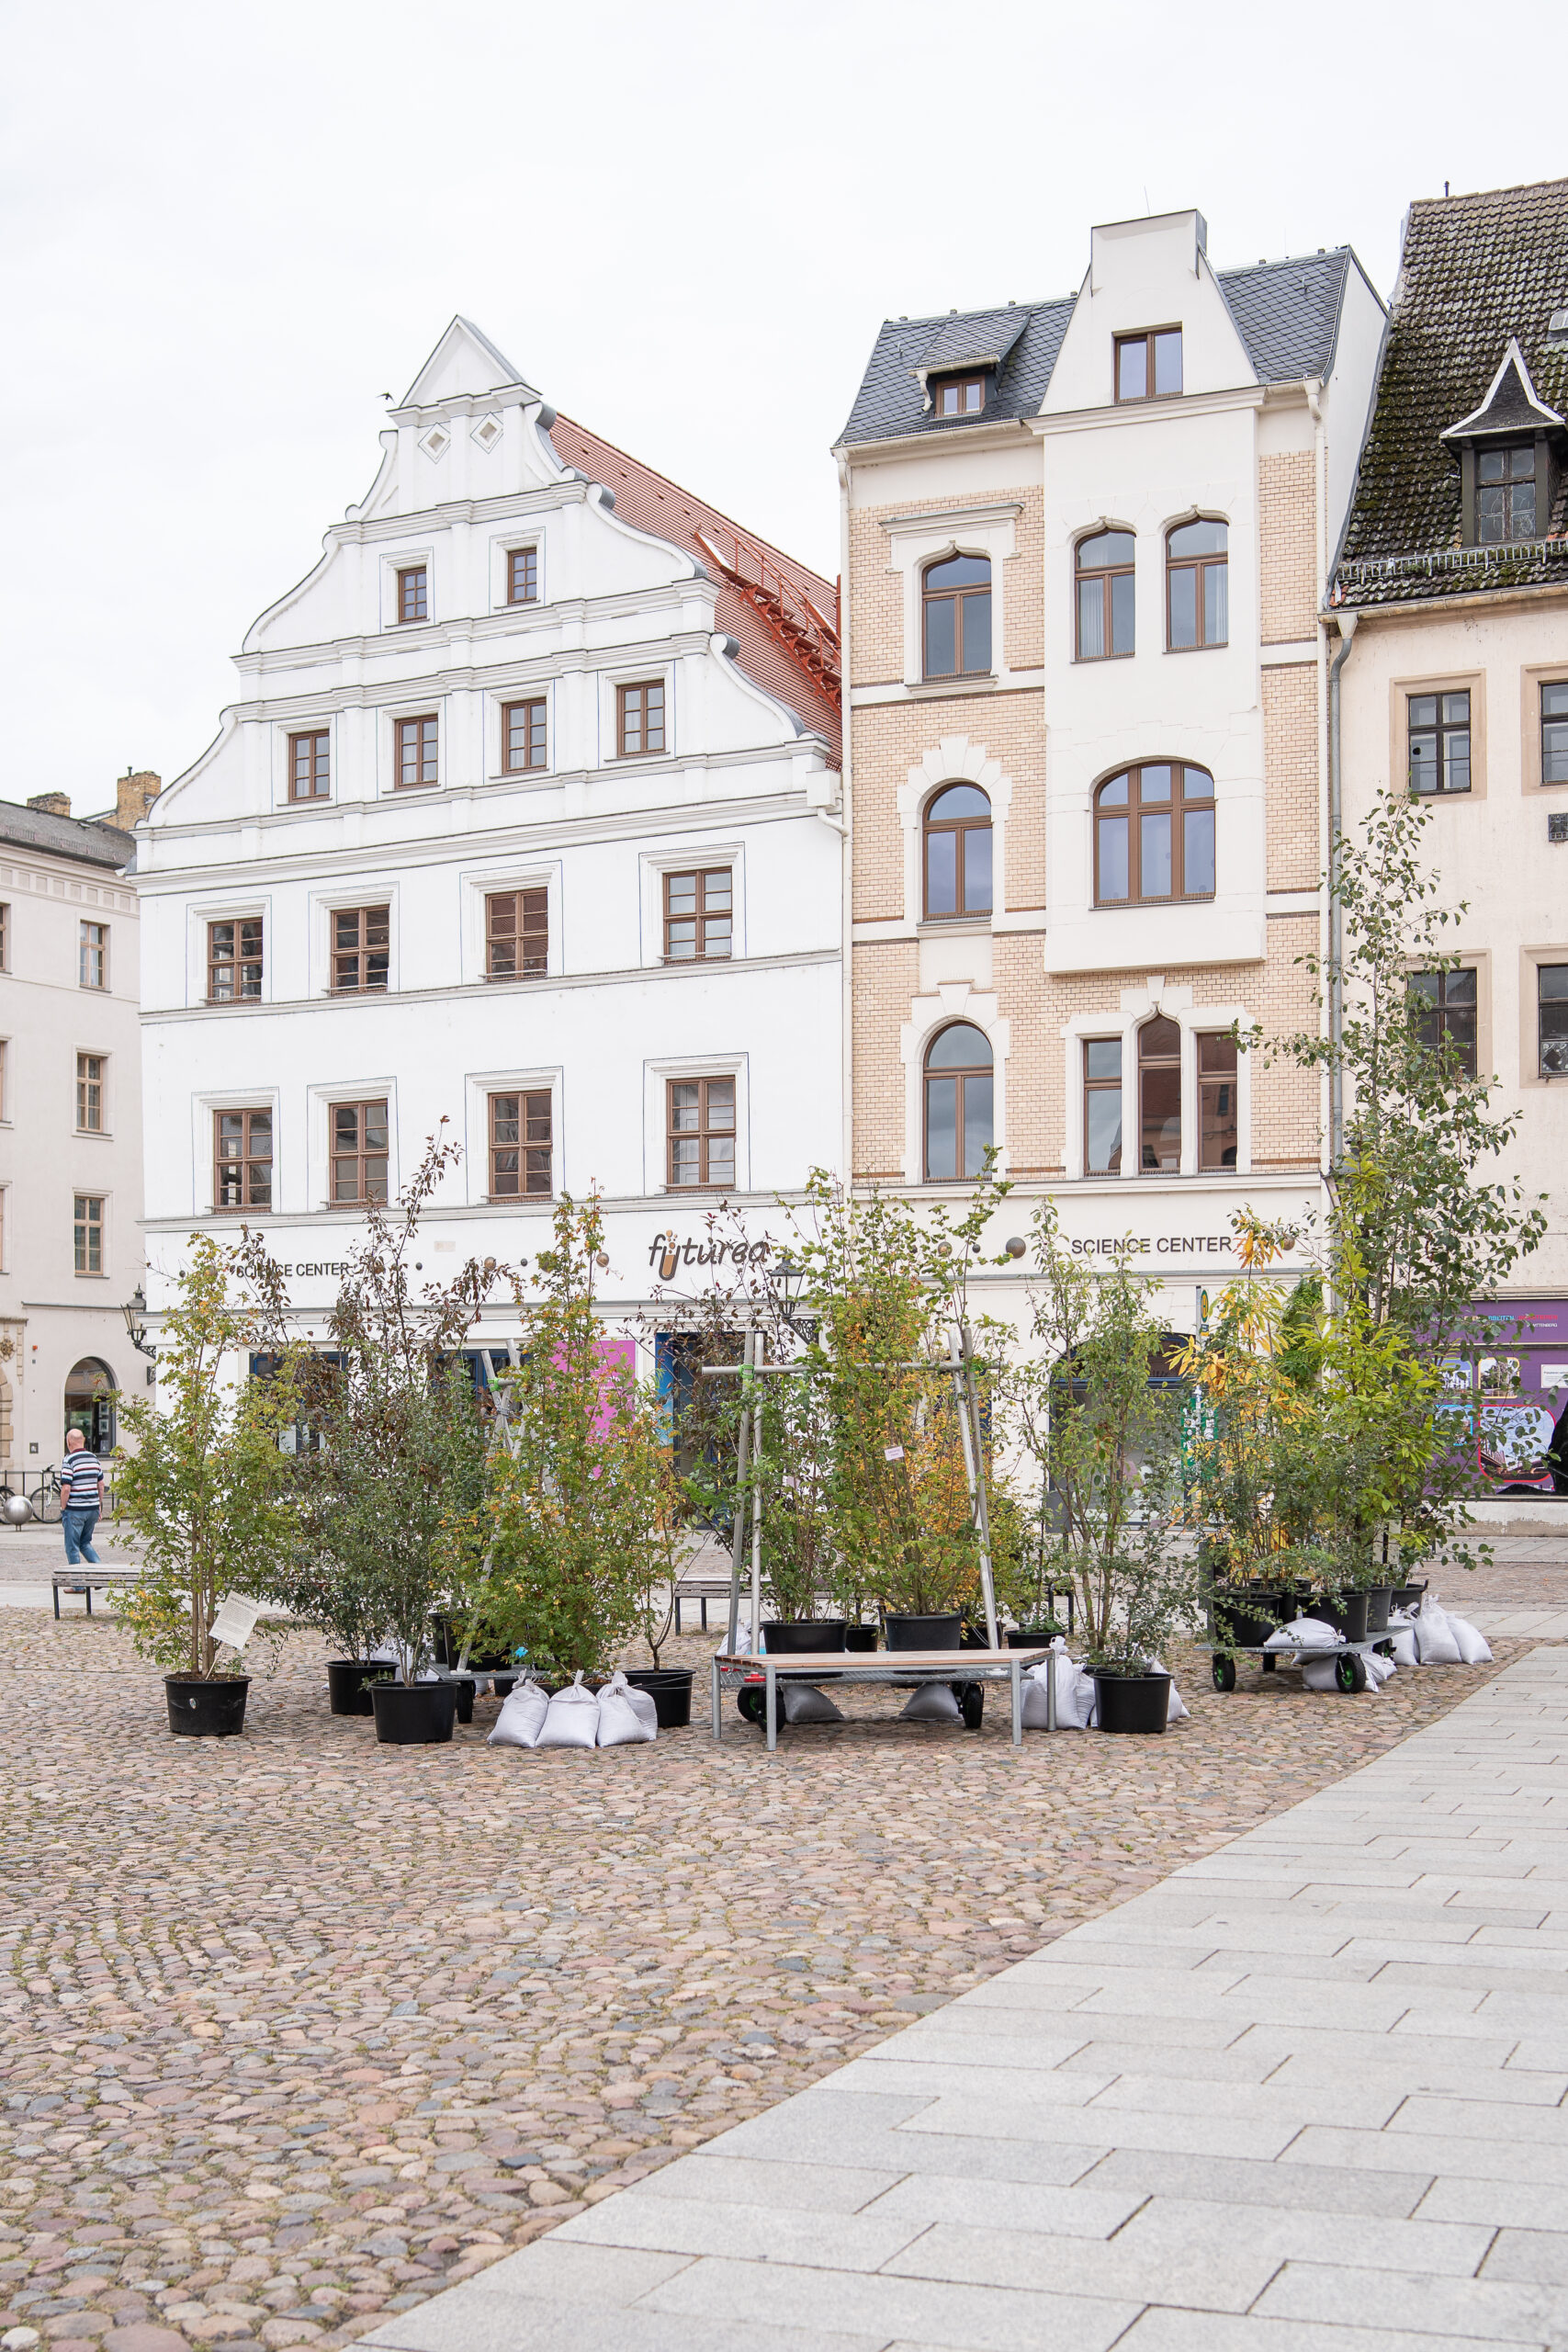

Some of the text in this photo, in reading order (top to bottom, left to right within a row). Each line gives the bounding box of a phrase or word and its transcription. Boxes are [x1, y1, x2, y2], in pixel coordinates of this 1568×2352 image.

[1071, 1236, 1232, 1254] SCIENCE CENTER
[296, 1261, 350, 1276] CENTER
